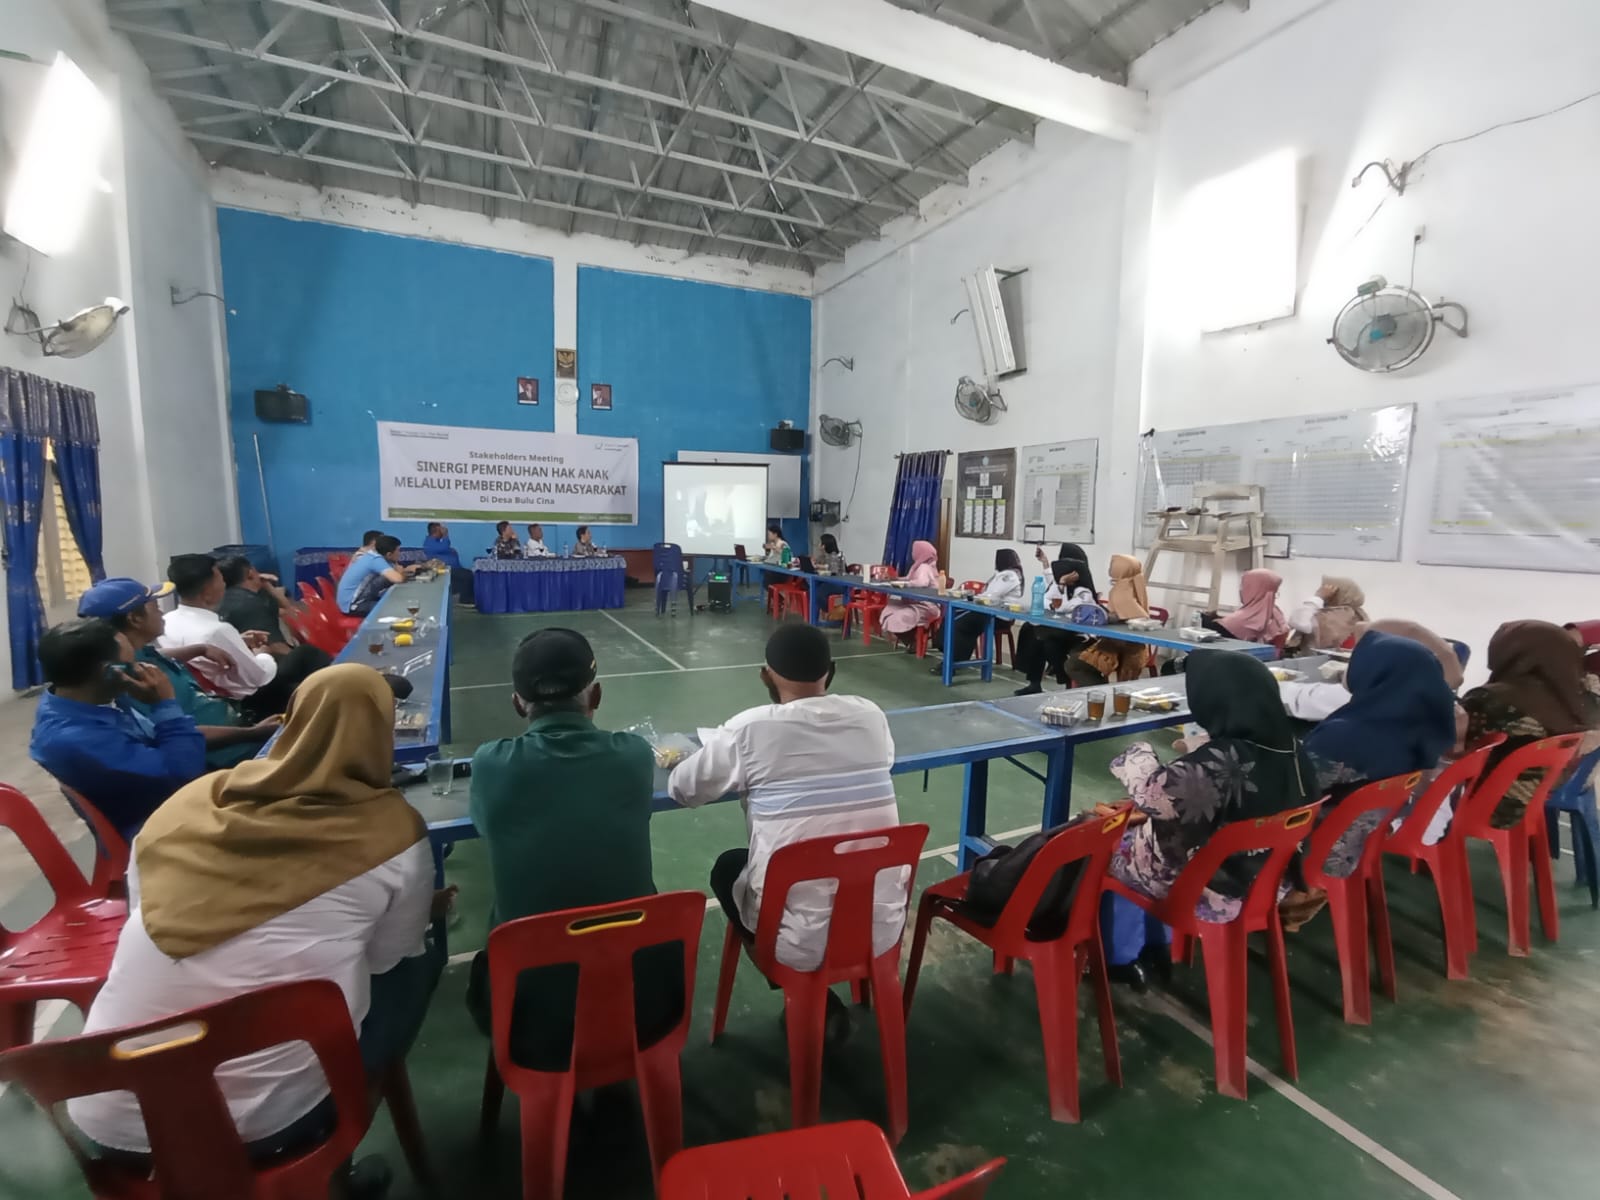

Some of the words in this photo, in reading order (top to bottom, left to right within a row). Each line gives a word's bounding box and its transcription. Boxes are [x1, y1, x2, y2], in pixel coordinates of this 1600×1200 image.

[469, 451, 527, 461] Stakeholders
[529, 454, 564, 464] Meeting
[416, 460, 469, 474] SINERGI
[471, 463, 548, 478] PEMENUHAN
[551, 467, 576, 478] HAK
[578, 468, 609, 480] ANAK
[394, 476, 451, 490] MELALUI
[454, 479, 552, 494] PEMBERDAYAAN
[555, 483, 627, 496] MASYARAKAT
[479, 495, 490, 503] Di
[491, 495, 513, 504] Desa
[514, 496, 535, 505] Bulu
[536, 497, 555, 505] Cina
